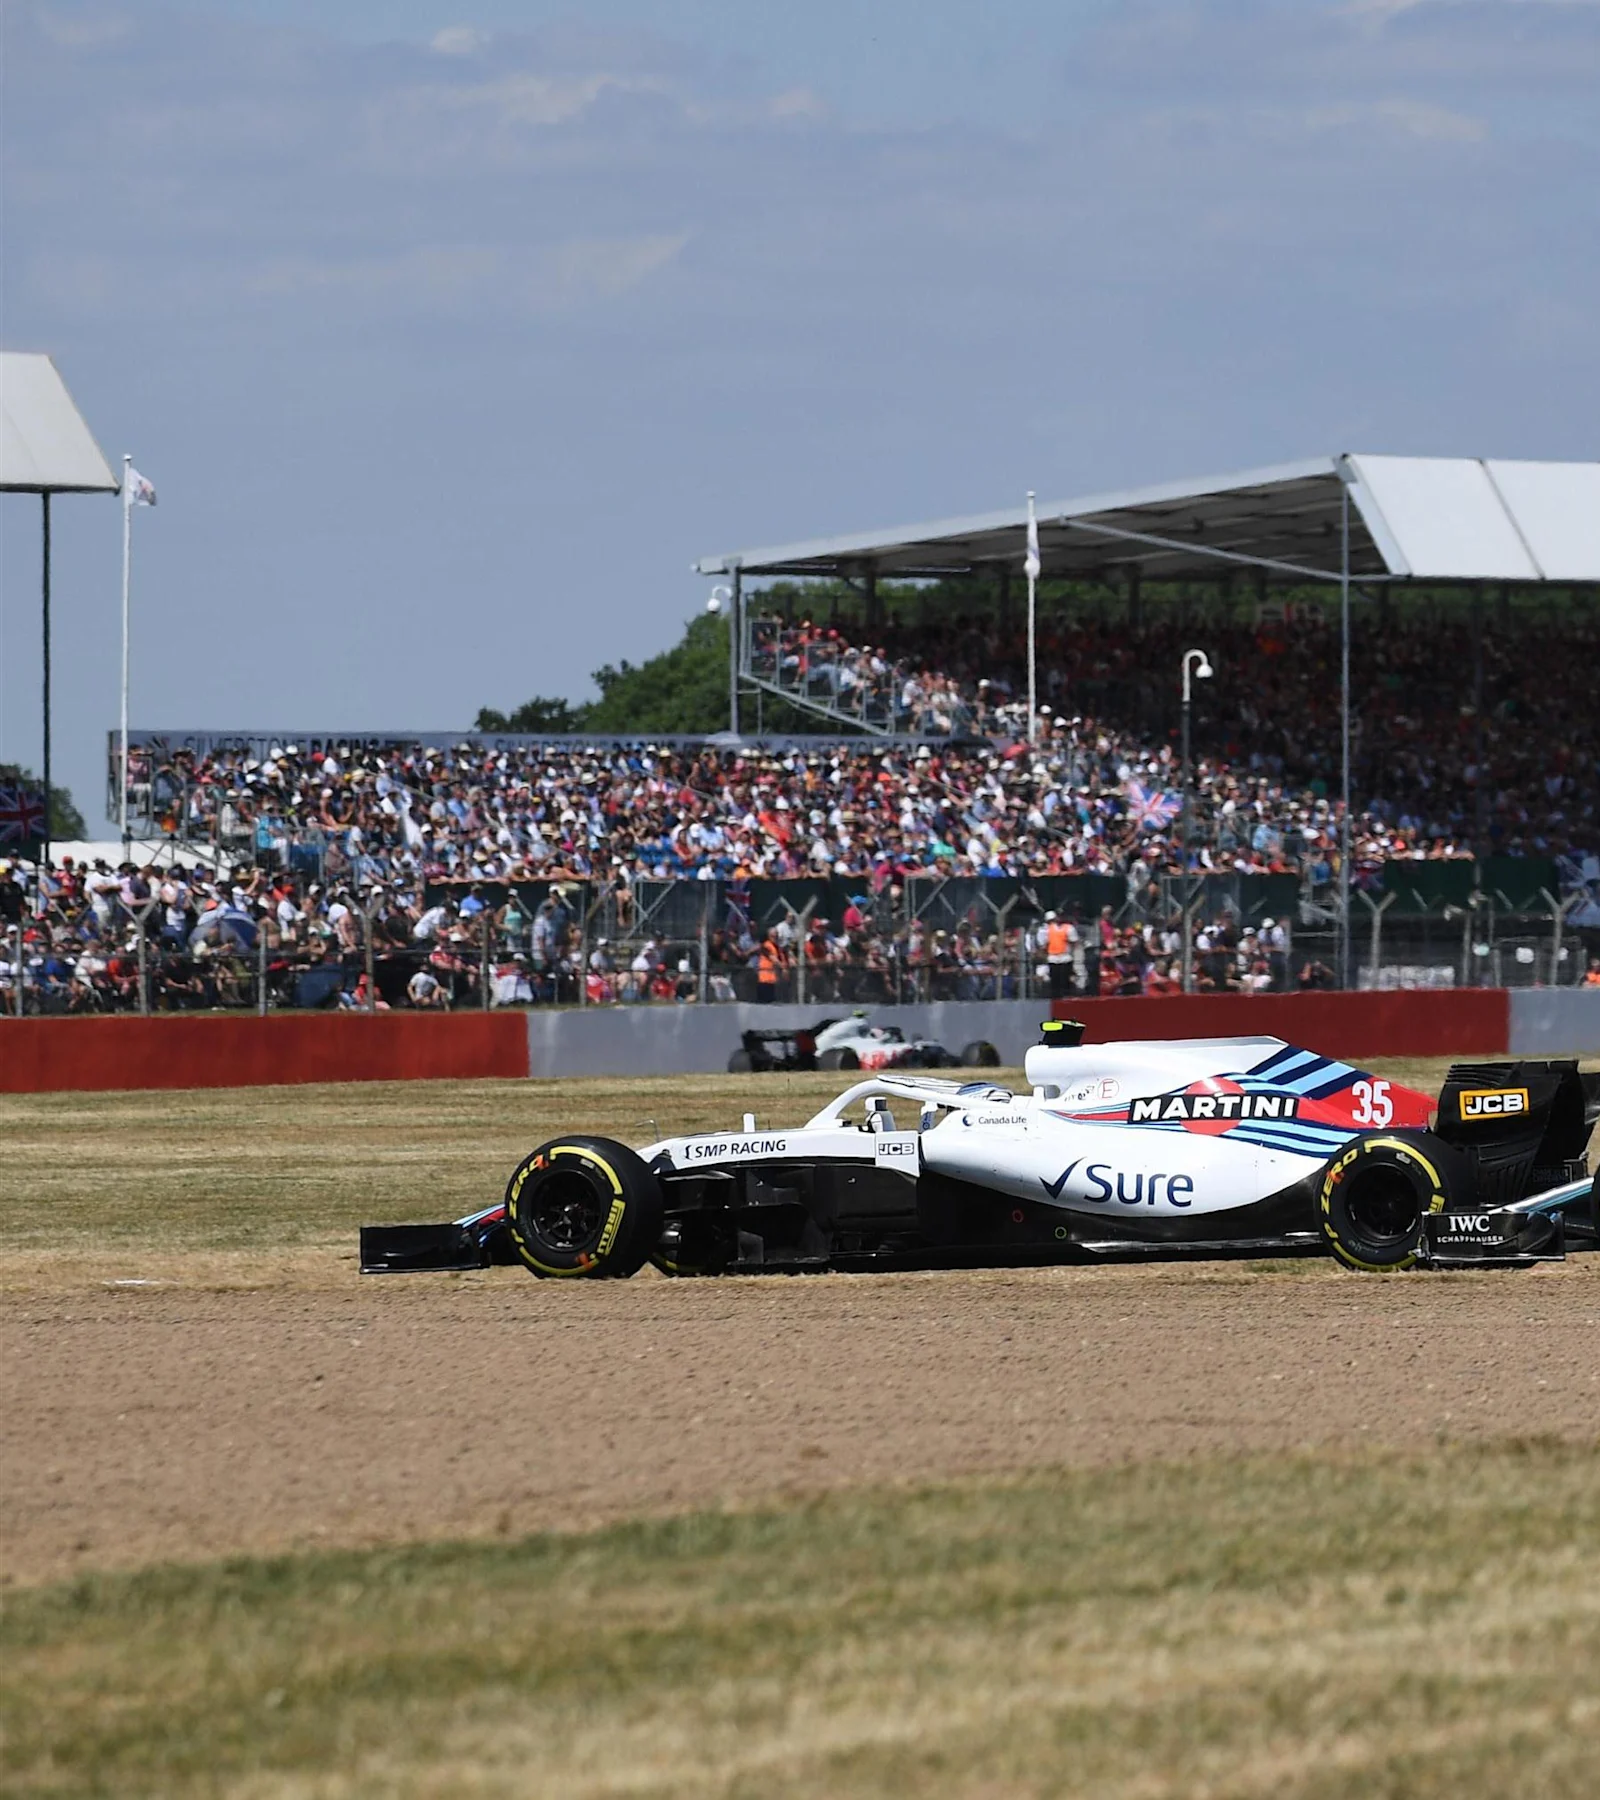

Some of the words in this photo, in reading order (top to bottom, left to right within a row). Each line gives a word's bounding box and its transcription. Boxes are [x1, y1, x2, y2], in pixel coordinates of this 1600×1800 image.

[1132, 1096, 1297, 1121] MARTINI
[1352, 1080, 1393, 1128] 35
[1466, 1094, 1523, 1113] JCB
[978, 1116, 1010, 1125] Canada
[1011, 1115, 1027, 1124] Life
[694, 1145, 727, 1159] SMP
[731, 1139, 787, 1155] RACING
[879, 1142, 915, 1155] JCB
[1084, 1164, 1194, 1208] Sure
[1449, 1215, 1491, 1232] IWC
